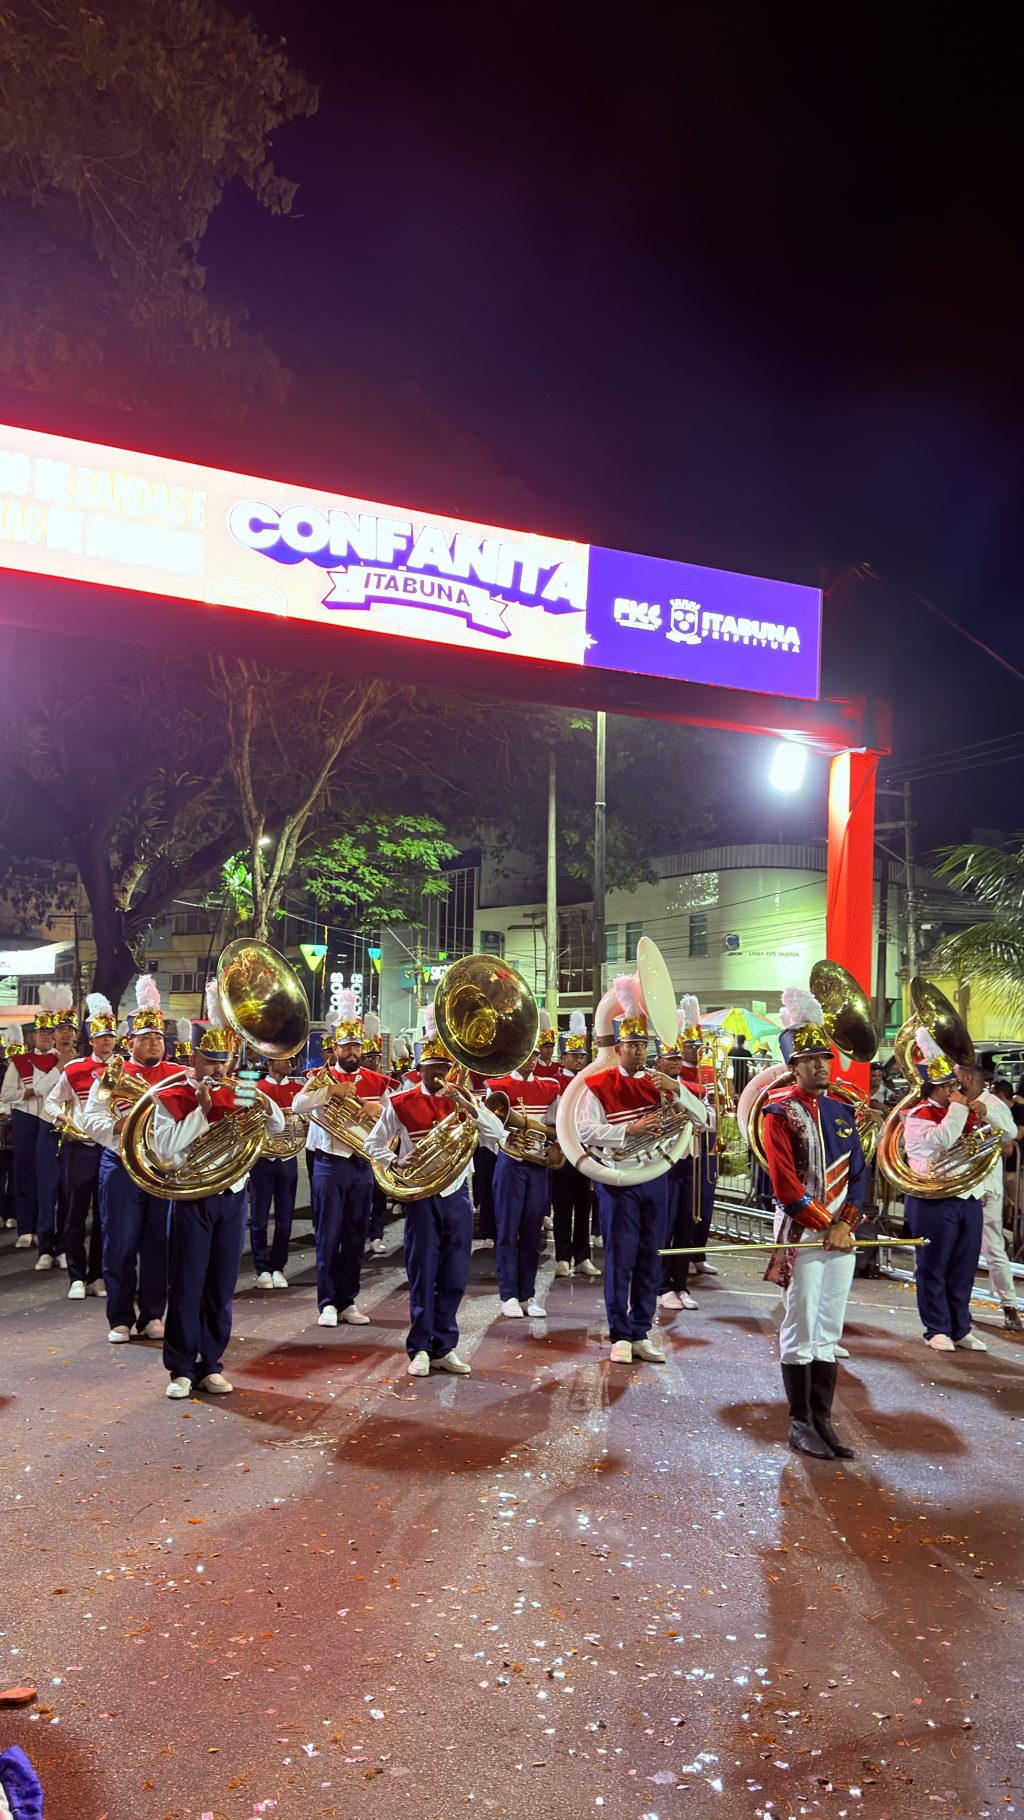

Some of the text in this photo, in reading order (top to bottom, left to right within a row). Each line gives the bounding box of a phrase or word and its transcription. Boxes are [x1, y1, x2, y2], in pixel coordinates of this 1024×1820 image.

[75, 466, 188, 525] BANDAS
[229, 501, 587, 611] CONFANITA
[364, 572, 471, 607] ITABUNA
[702, 611, 801, 646] ITABUNA
